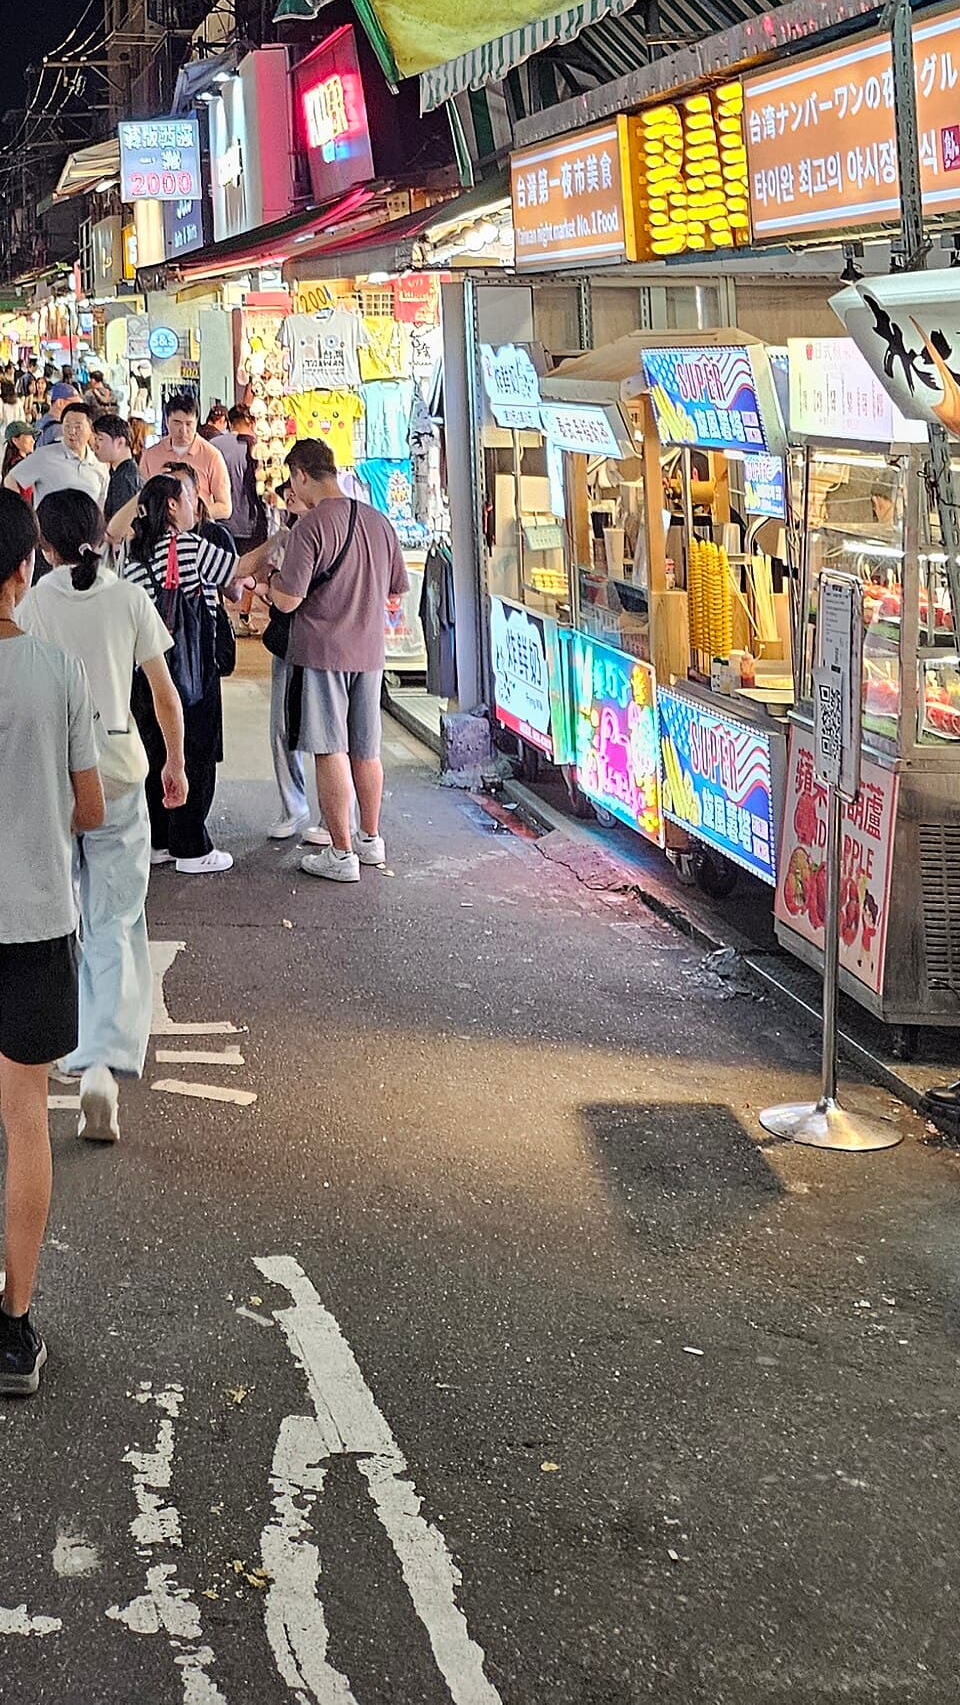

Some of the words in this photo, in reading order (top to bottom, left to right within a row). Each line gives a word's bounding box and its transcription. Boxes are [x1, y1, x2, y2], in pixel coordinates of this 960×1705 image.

[129, 171, 193, 196] 2000
[753, 165, 795, 207] 타이완
[798, 150, 844, 198] 최고의
[576, 214, 591, 237] No.
[597, 206, 619, 233] Food
[676, 362, 727, 403] SUPER
[688, 718, 740, 793] SUPER
